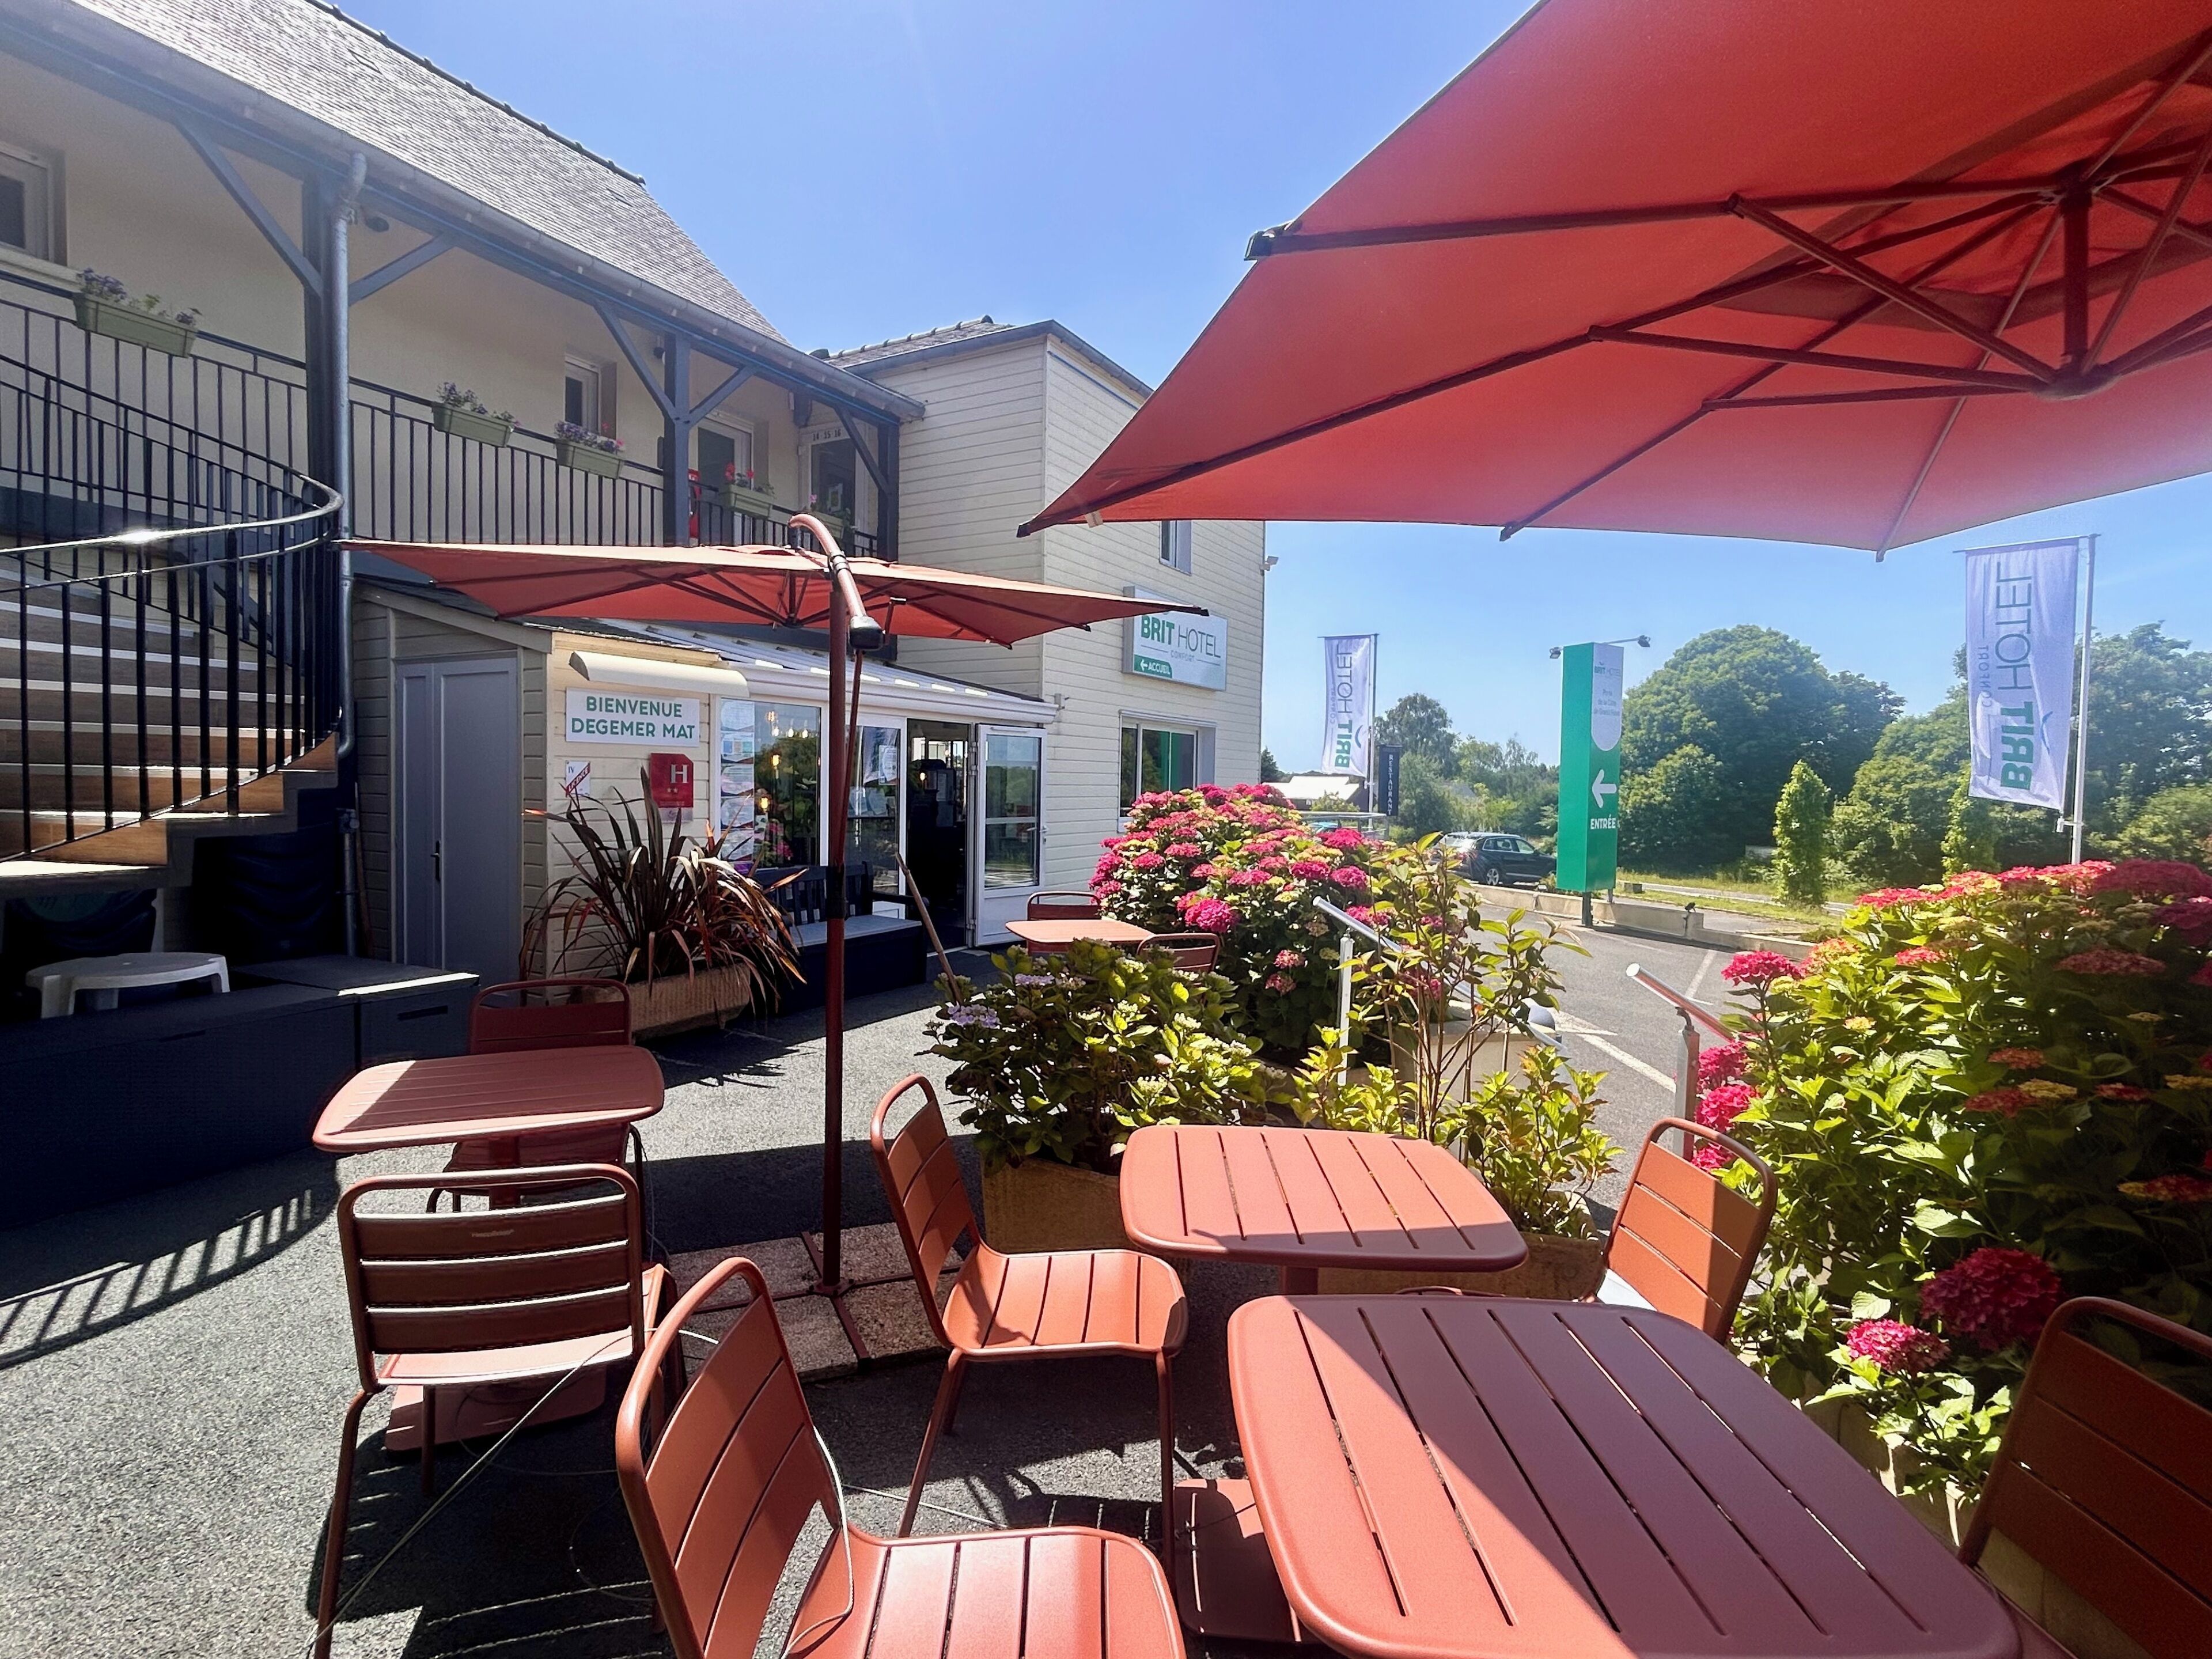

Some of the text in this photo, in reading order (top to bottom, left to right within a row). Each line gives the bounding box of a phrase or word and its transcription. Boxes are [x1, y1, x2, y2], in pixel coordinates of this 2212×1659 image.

[1141, 615, 1221, 658] BRIT HOTEL
[1147, 662, 1171, 675] ACCUEIL
[586, 696, 683, 718] BIENVENUE
[571, 718, 695, 739] DEGEMER MAT
[568, 765, 589, 792] LICENCE
[670, 764, 688, 783] H
[1590, 814, 1616, 830] ENTRÉE
